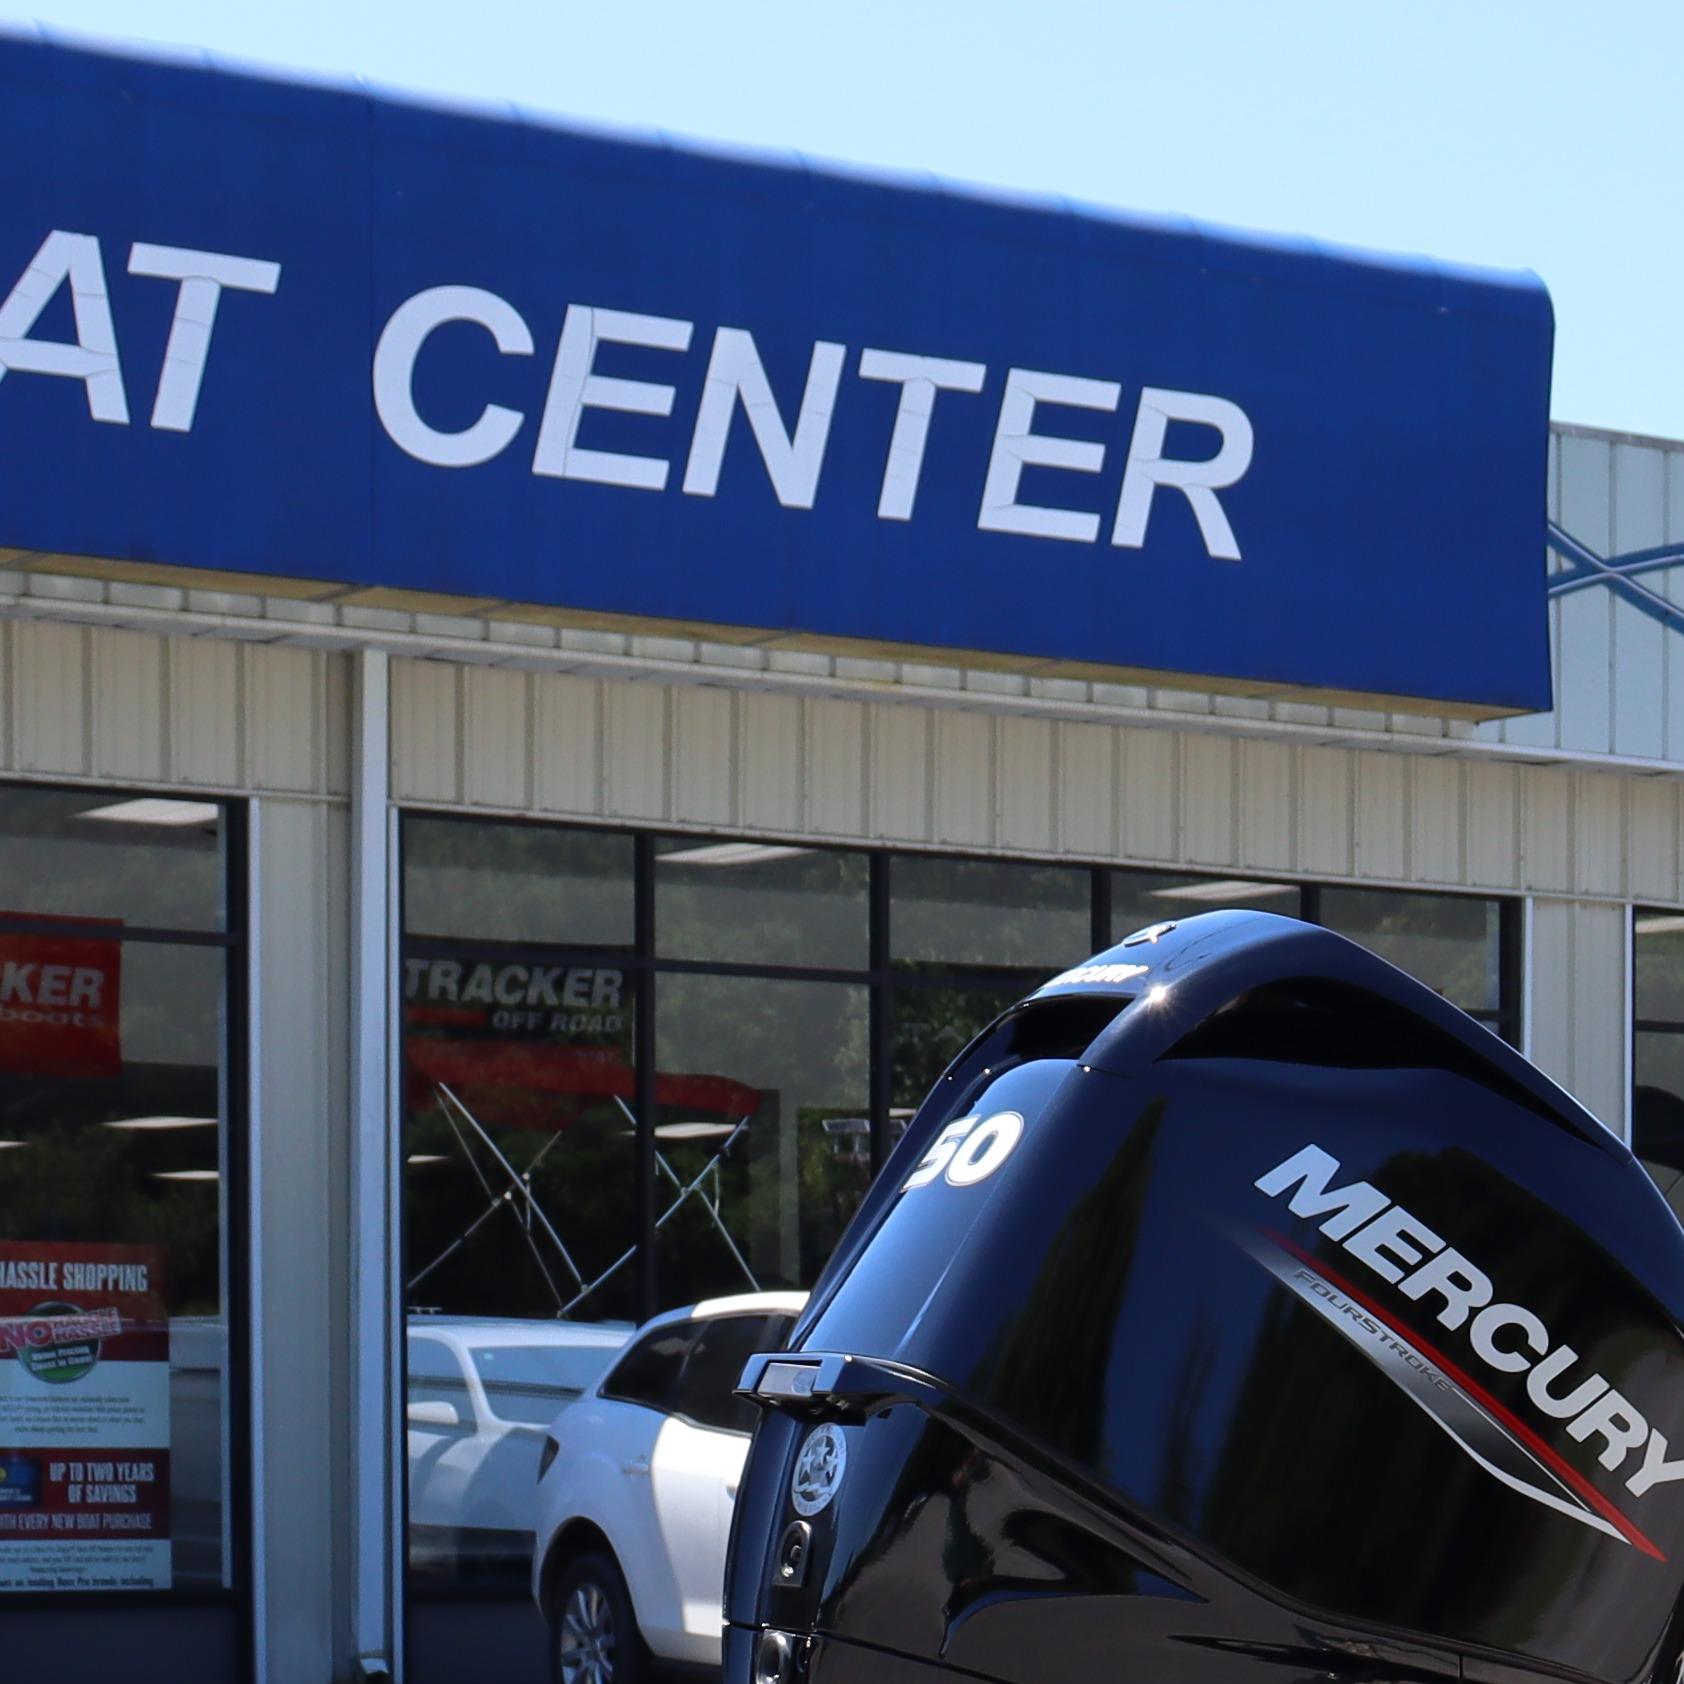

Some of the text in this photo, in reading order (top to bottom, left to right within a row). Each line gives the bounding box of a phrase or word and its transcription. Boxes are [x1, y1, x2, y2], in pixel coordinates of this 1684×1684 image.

[373, 284, 1256, 561] CENTER
[404, 957, 625, 1009] TRACKER
[492, 1010, 623, 1034] OFF ROAD
[900, 1110, 1025, 1193] 50
[63, 1263, 148, 1291] SHOPPING
[1294, 1267, 1452, 1393] FOURSTROKE
[49, 1462, 155, 1482] UP TO TWO YEARS
[68, 1484, 137, 1504] OF SAVINGS
[18, 1513, 49, 1530] EVERY
[51, 1513, 75, 1529] NEW
[77, 1513, 100, 1529] BOAT
[102, 1513, 152, 1530] PURCHASE
